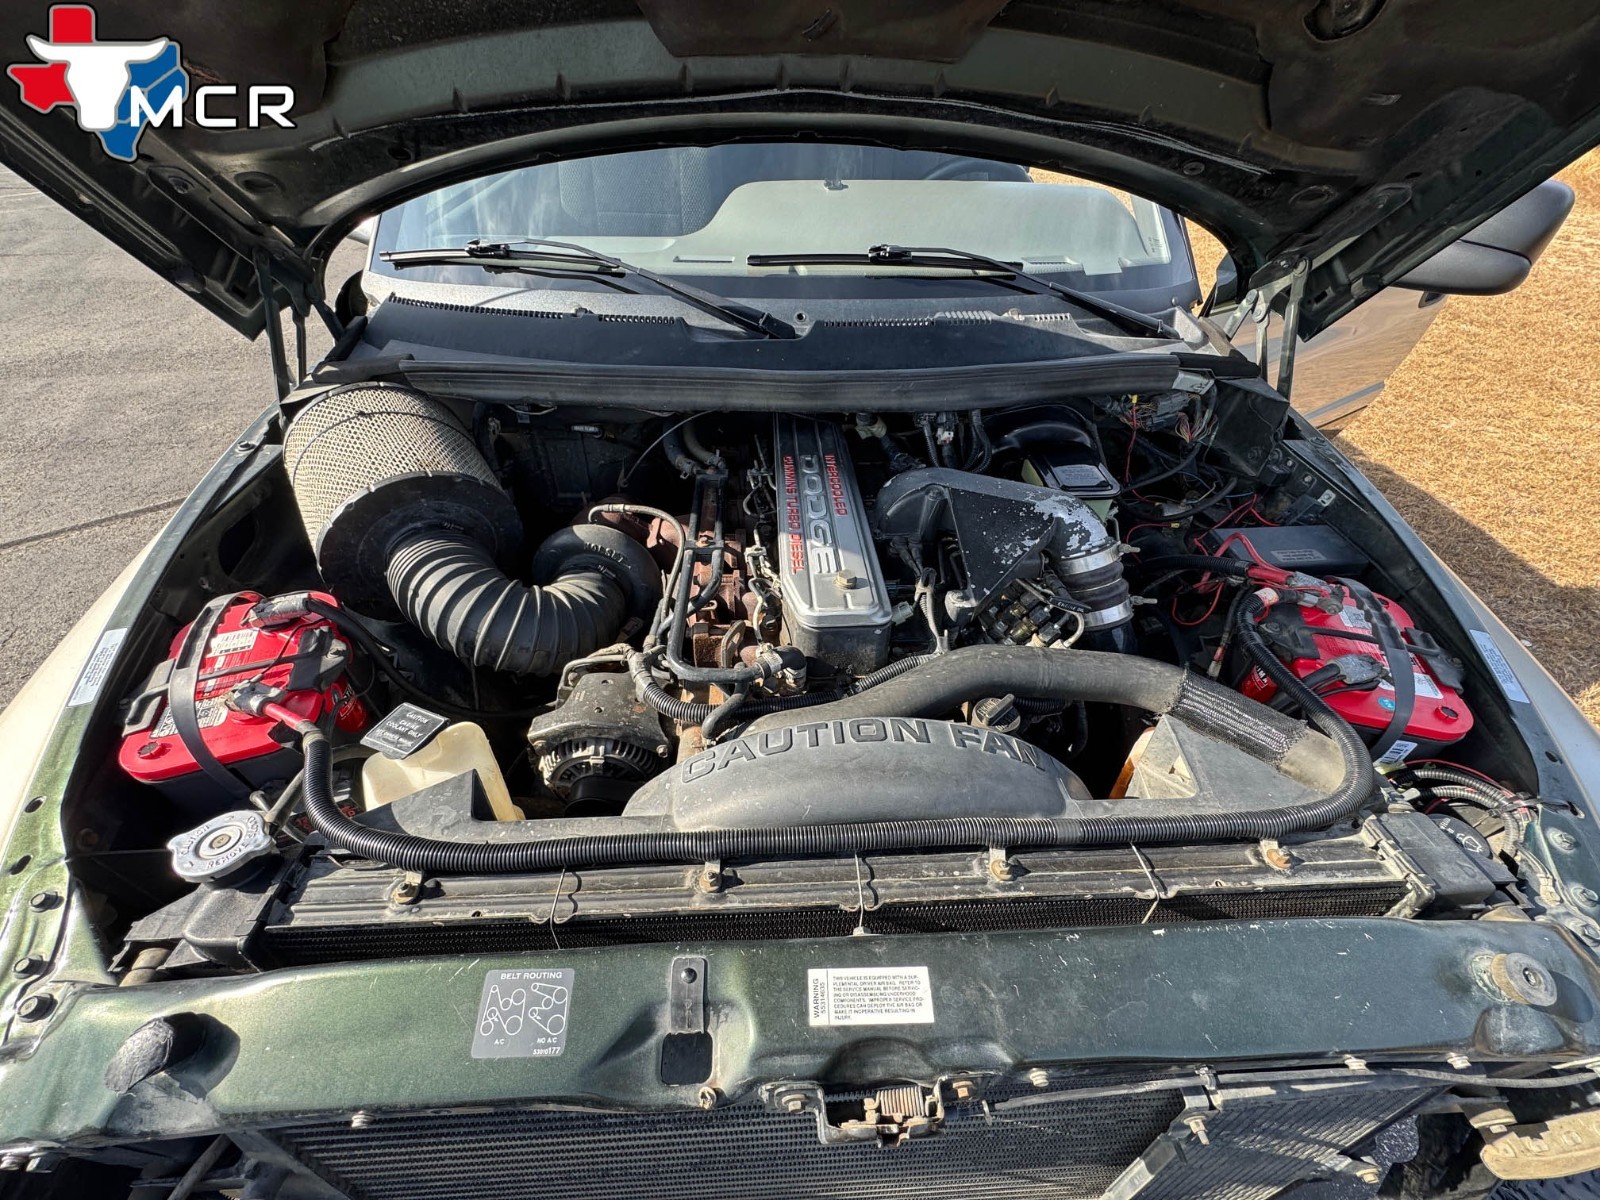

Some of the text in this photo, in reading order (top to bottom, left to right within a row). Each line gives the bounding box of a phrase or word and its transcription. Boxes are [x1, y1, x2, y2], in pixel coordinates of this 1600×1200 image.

[824, 454, 848, 516] INTERCOOLED
[783, 455, 804, 574] CUMMINS TURBO DIESEL
[800, 454, 838, 574] DODGE
[386, 720, 424, 738] COOLANT ONLY
[406, 711, 429, 724] CAUTION
[680, 718, 1046, 784] CAUTION FAN
[207, 841, 250, 869] REMOVE
[500, 971, 562, 980] BELT ROUTING
[812, 978, 820, 1019] WARNING
